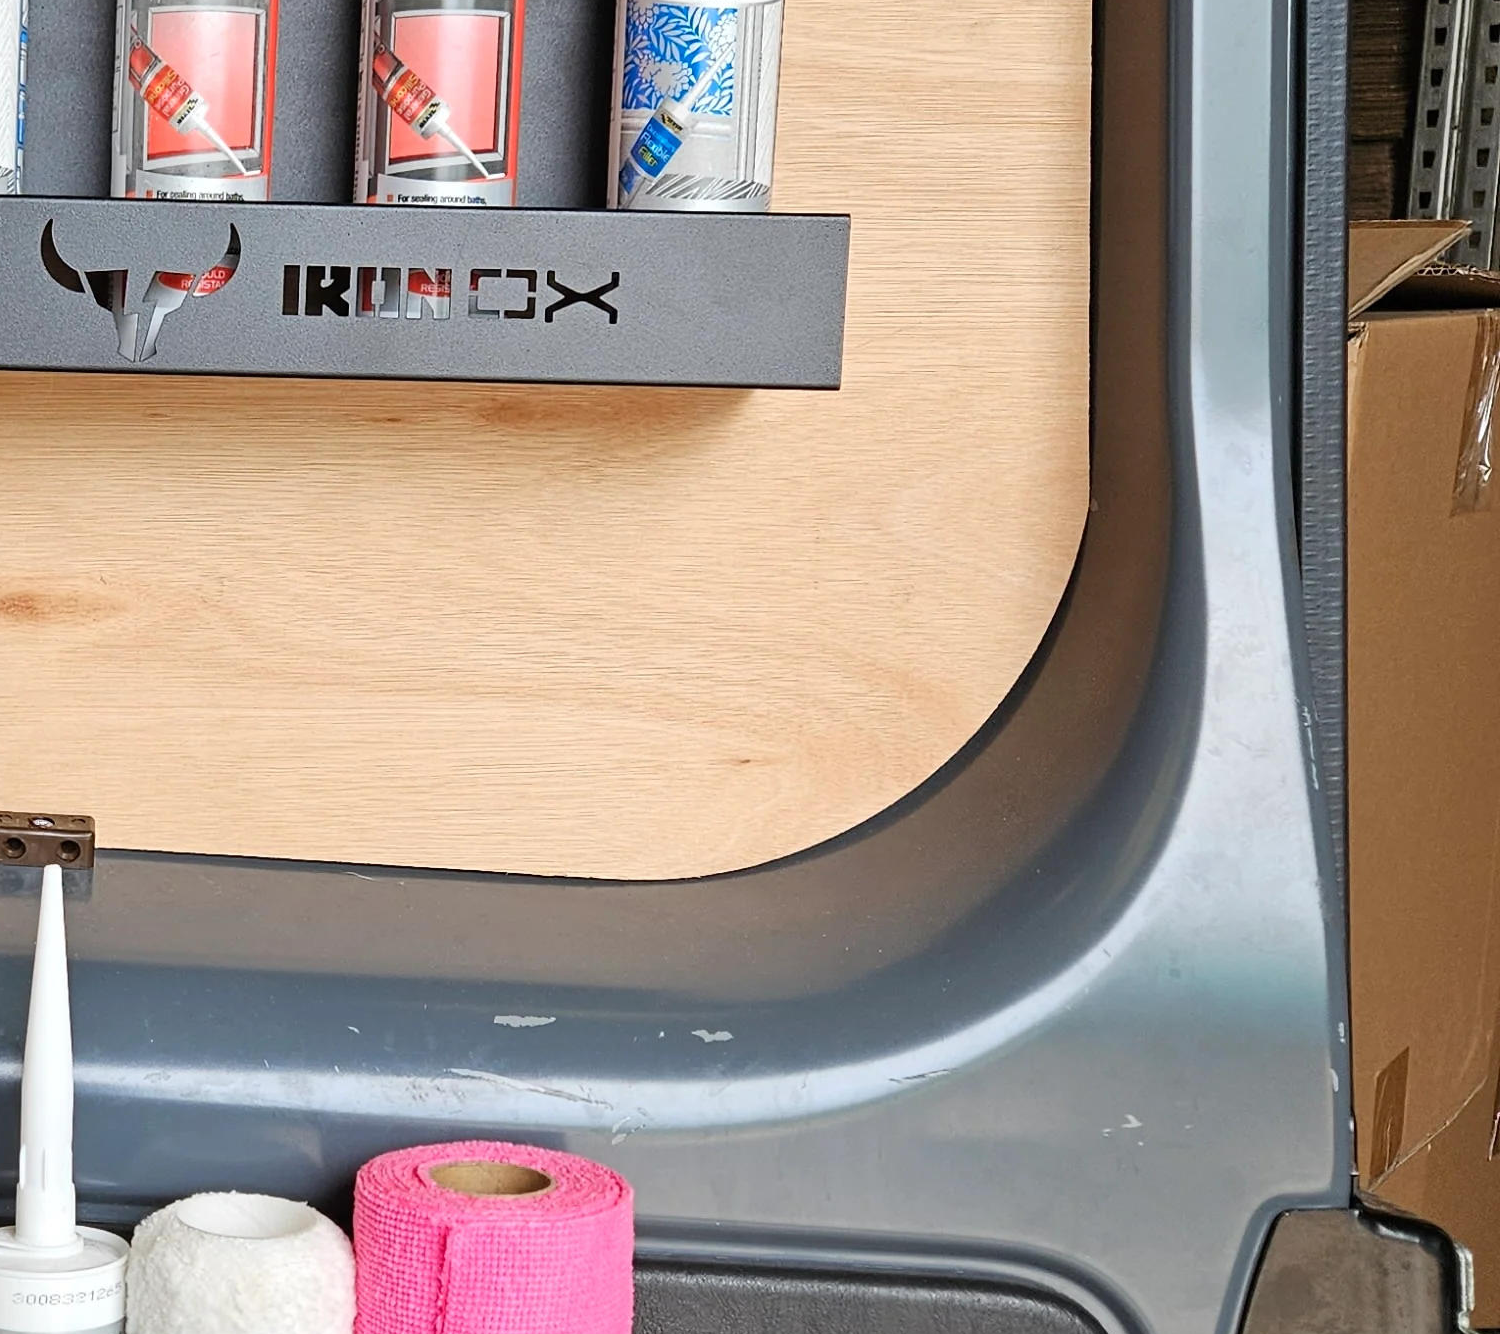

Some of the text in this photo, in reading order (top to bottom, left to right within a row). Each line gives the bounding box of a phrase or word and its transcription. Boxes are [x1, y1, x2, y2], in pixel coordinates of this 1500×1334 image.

[397, 194, 410, 203] For
[411, 194, 438, 205] sealing
[440, 195, 466, 204] around
[282, 264, 620, 325] IRON OX
